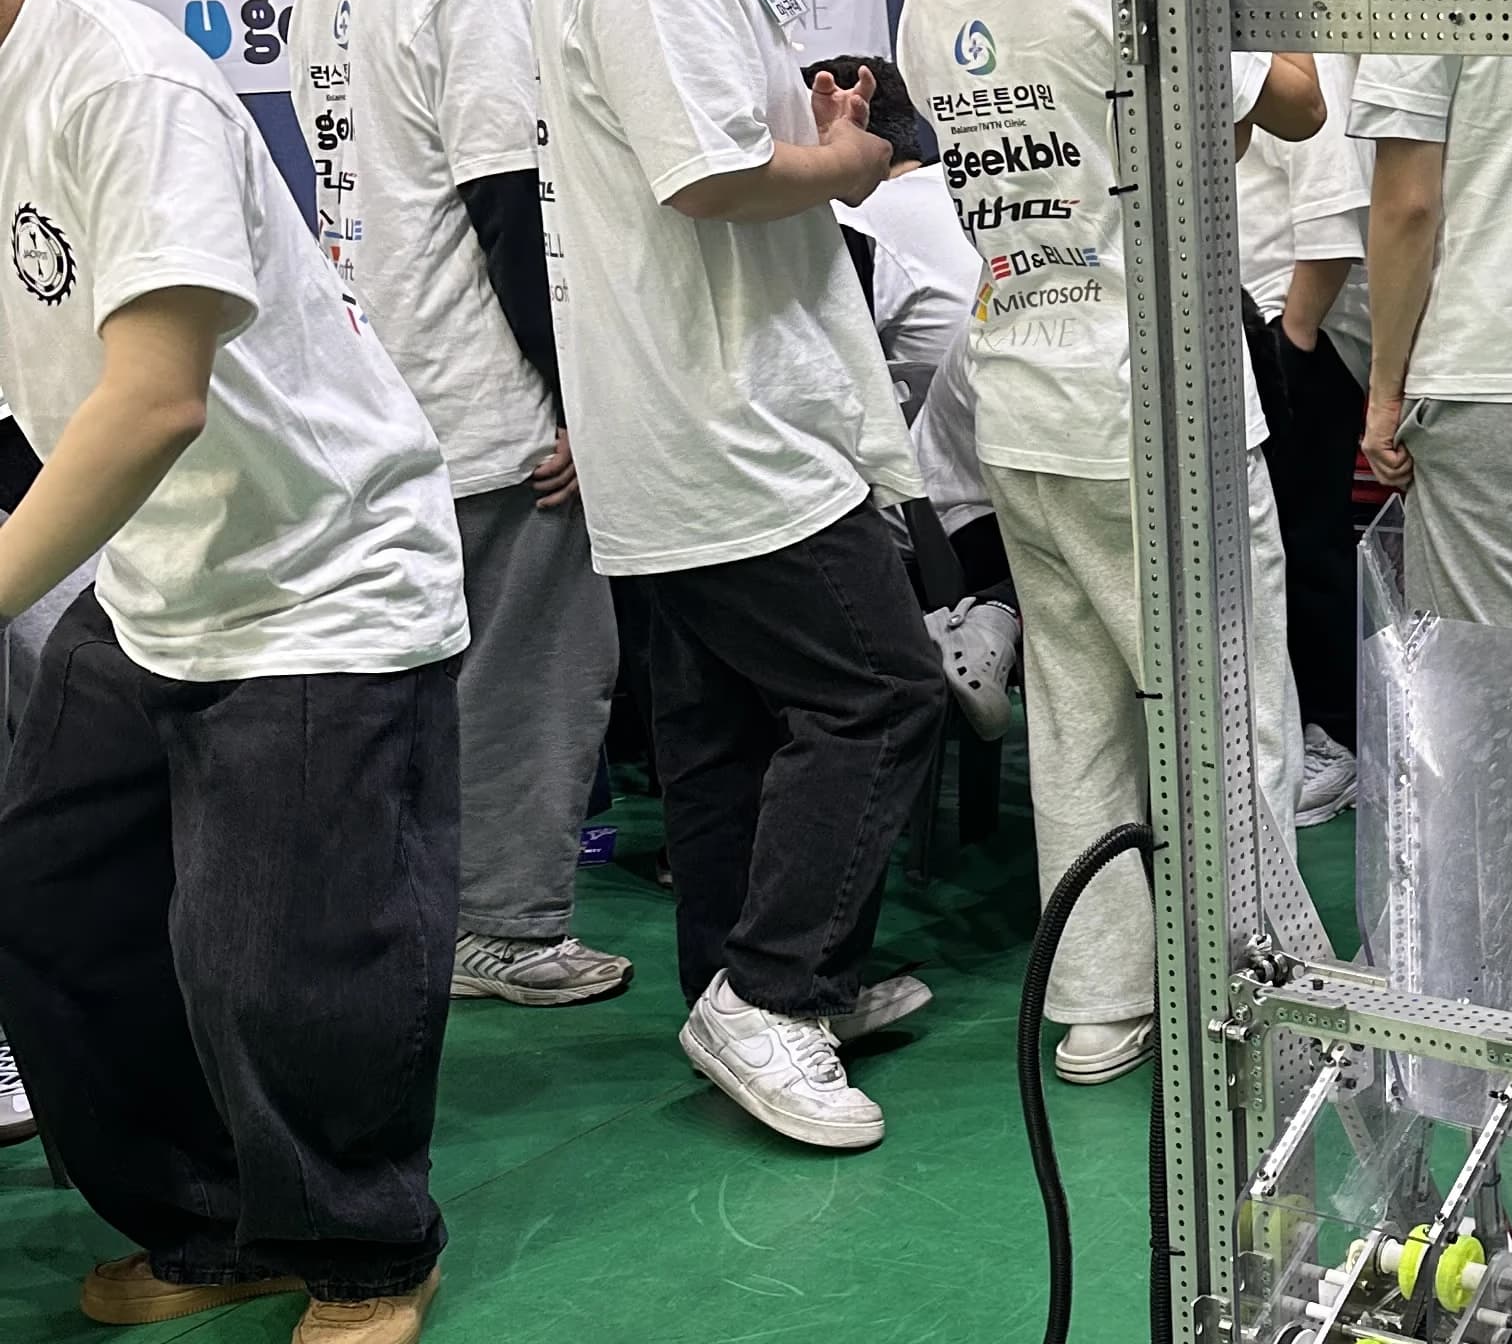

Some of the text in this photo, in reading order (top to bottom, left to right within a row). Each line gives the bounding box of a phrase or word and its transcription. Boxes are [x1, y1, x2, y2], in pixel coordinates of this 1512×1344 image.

[928, 84, 1056, 122] 런스튼튼의원
[943, 131, 1081, 189] geekble
[988, 245, 1100, 280] ED&BLUE
[992, 279, 1101, 316] Microsoft
[976, 318, 1077, 353] KAINE
